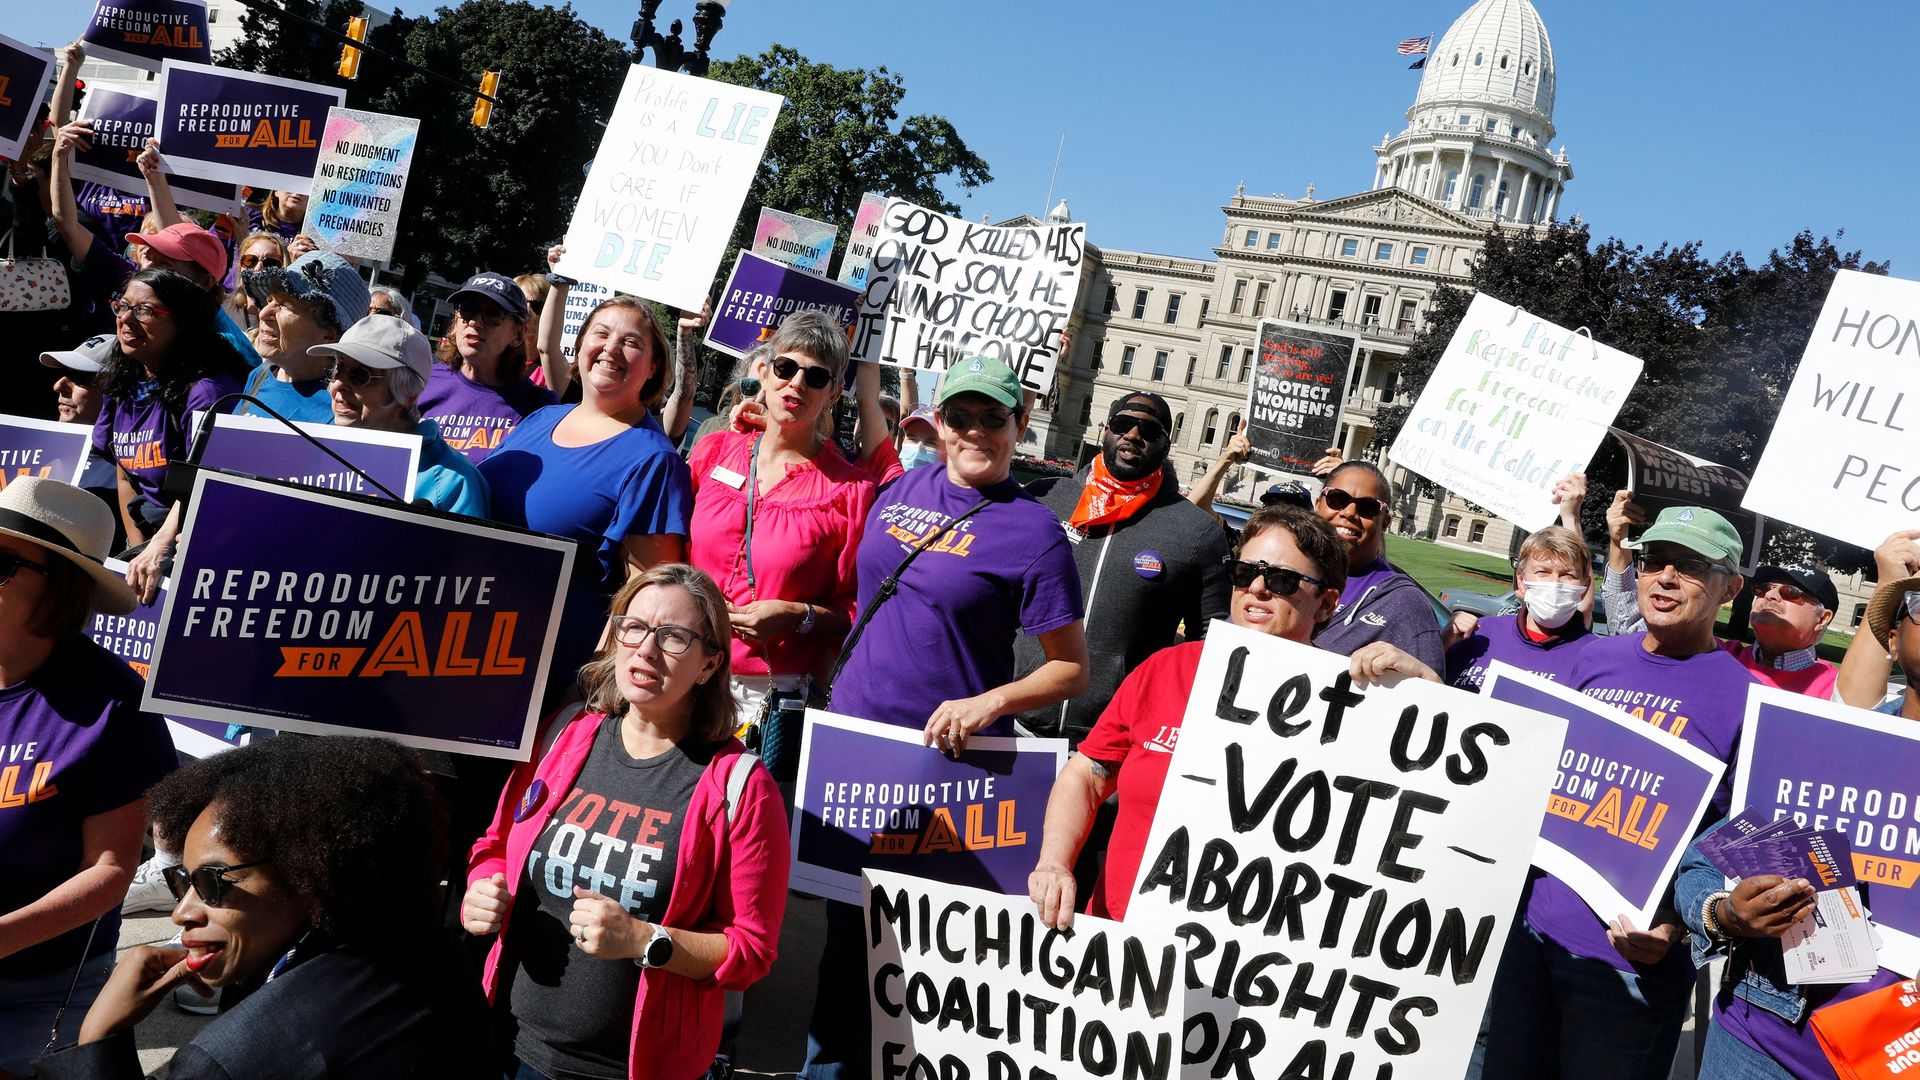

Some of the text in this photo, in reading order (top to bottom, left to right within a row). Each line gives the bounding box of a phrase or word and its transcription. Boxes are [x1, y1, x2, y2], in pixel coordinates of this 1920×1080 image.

[99, 6, 189, 25] REPRODUCTIVE
[96, 17, 203, 48] FREEDOM ALL
[180, 104, 299, 118] REPRODUCTIVE
[634, 74, 769, 145] Prolife LIE
[640, 111, 677, 133] IS A
[178, 119, 317, 148] FREEDOM ALL
[335, 140, 401, 163] NO JUDGMENT
[629, 141, 669, 166] YOU
[321, 163, 404, 189] NO RESTRICTIONS
[610, 172, 701, 203] CARE IF
[322, 189, 391, 212] NO UNWANTED
[318, 214, 384, 237] PREGNANCIES
[593, 198, 699, 243] WOMEN
[866, 224, 878, 237] NO
[883, 202, 1084, 266] GOD KILLED HIS
[593, 232, 671, 281] DIE
[766, 236, 821, 260] NO JUDGMENT
[852, 243, 864, 256] NO
[472, 278, 504, 290] 1973
[852, 266, 864, 280] NO
[874, 239, 1075, 307] ONLY SON, HE
[866, 275, 1068, 352] CANNOT CHOOSE
[852, 313, 1051, 390] IF I HAVE ONE
[1264, 338, 1323, 359] God is still
[1521, 322, 1576, 361] Put
[1282, 368, 1294, 377] so
[1296, 371, 1313, 381] are
[1315, 373, 1335, 385] we!
[1465, 329, 1617, 406] Reproductive
[1257, 376, 1331, 401] PROTECT
[1477, 371, 1569, 421] Freedom
[1813, 373, 1905, 431] WILL
[1254, 406, 1304, 429] LIVES!
[1256, 390, 1335, 418] WOMEN'S
[1445, 387, 1530, 439] for All
[1417, 417, 1447, 440] on
[1452, 420, 1488, 455] the
[133, 441, 168, 469] ALL
[1640, 453, 1745, 490] WOMEN'S
[1643, 468, 1711, 498] LIVES!
[193, 568, 496, 606] REPRODUCTIVE
[95, 613, 156, 640] REPROD
[183, 606, 527, 678] FREEDOM ALL
[298, 652, 340, 671] FOR
[1215, 646, 1366, 746] Let
[1581, 687, 1682, 713] REPRODUCTIVE
[1389, 704, 1511, 786] US
[824, 776, 996, 805] REPRODUCTIVE
[557, 788, 673, 851] VOTE
[1225, 742, 1451, 884] VOTE
[1552, 799, 1577, 816] FOR
[1584, 787, 1670, 851] ALL
[822, 799, 1027, 855] FREEDOM ALL
[880, 837, 905, 851] FOR
[1808, 836, 1827, 863] FREEDOM
[1815, 835, 1842, 877] REPRODUCTIVE
[1814, 862, 1838, 887] ALL
[1863, 859, 1903, 881] FOR
[1139, 825, 1496, 986] ABORTION
[869, 883, 1177, 1020] MICHIGAN
[1174, 922, 1439, 1056] RIGHTS
[873, 962, 1172, 1080] COALITION
